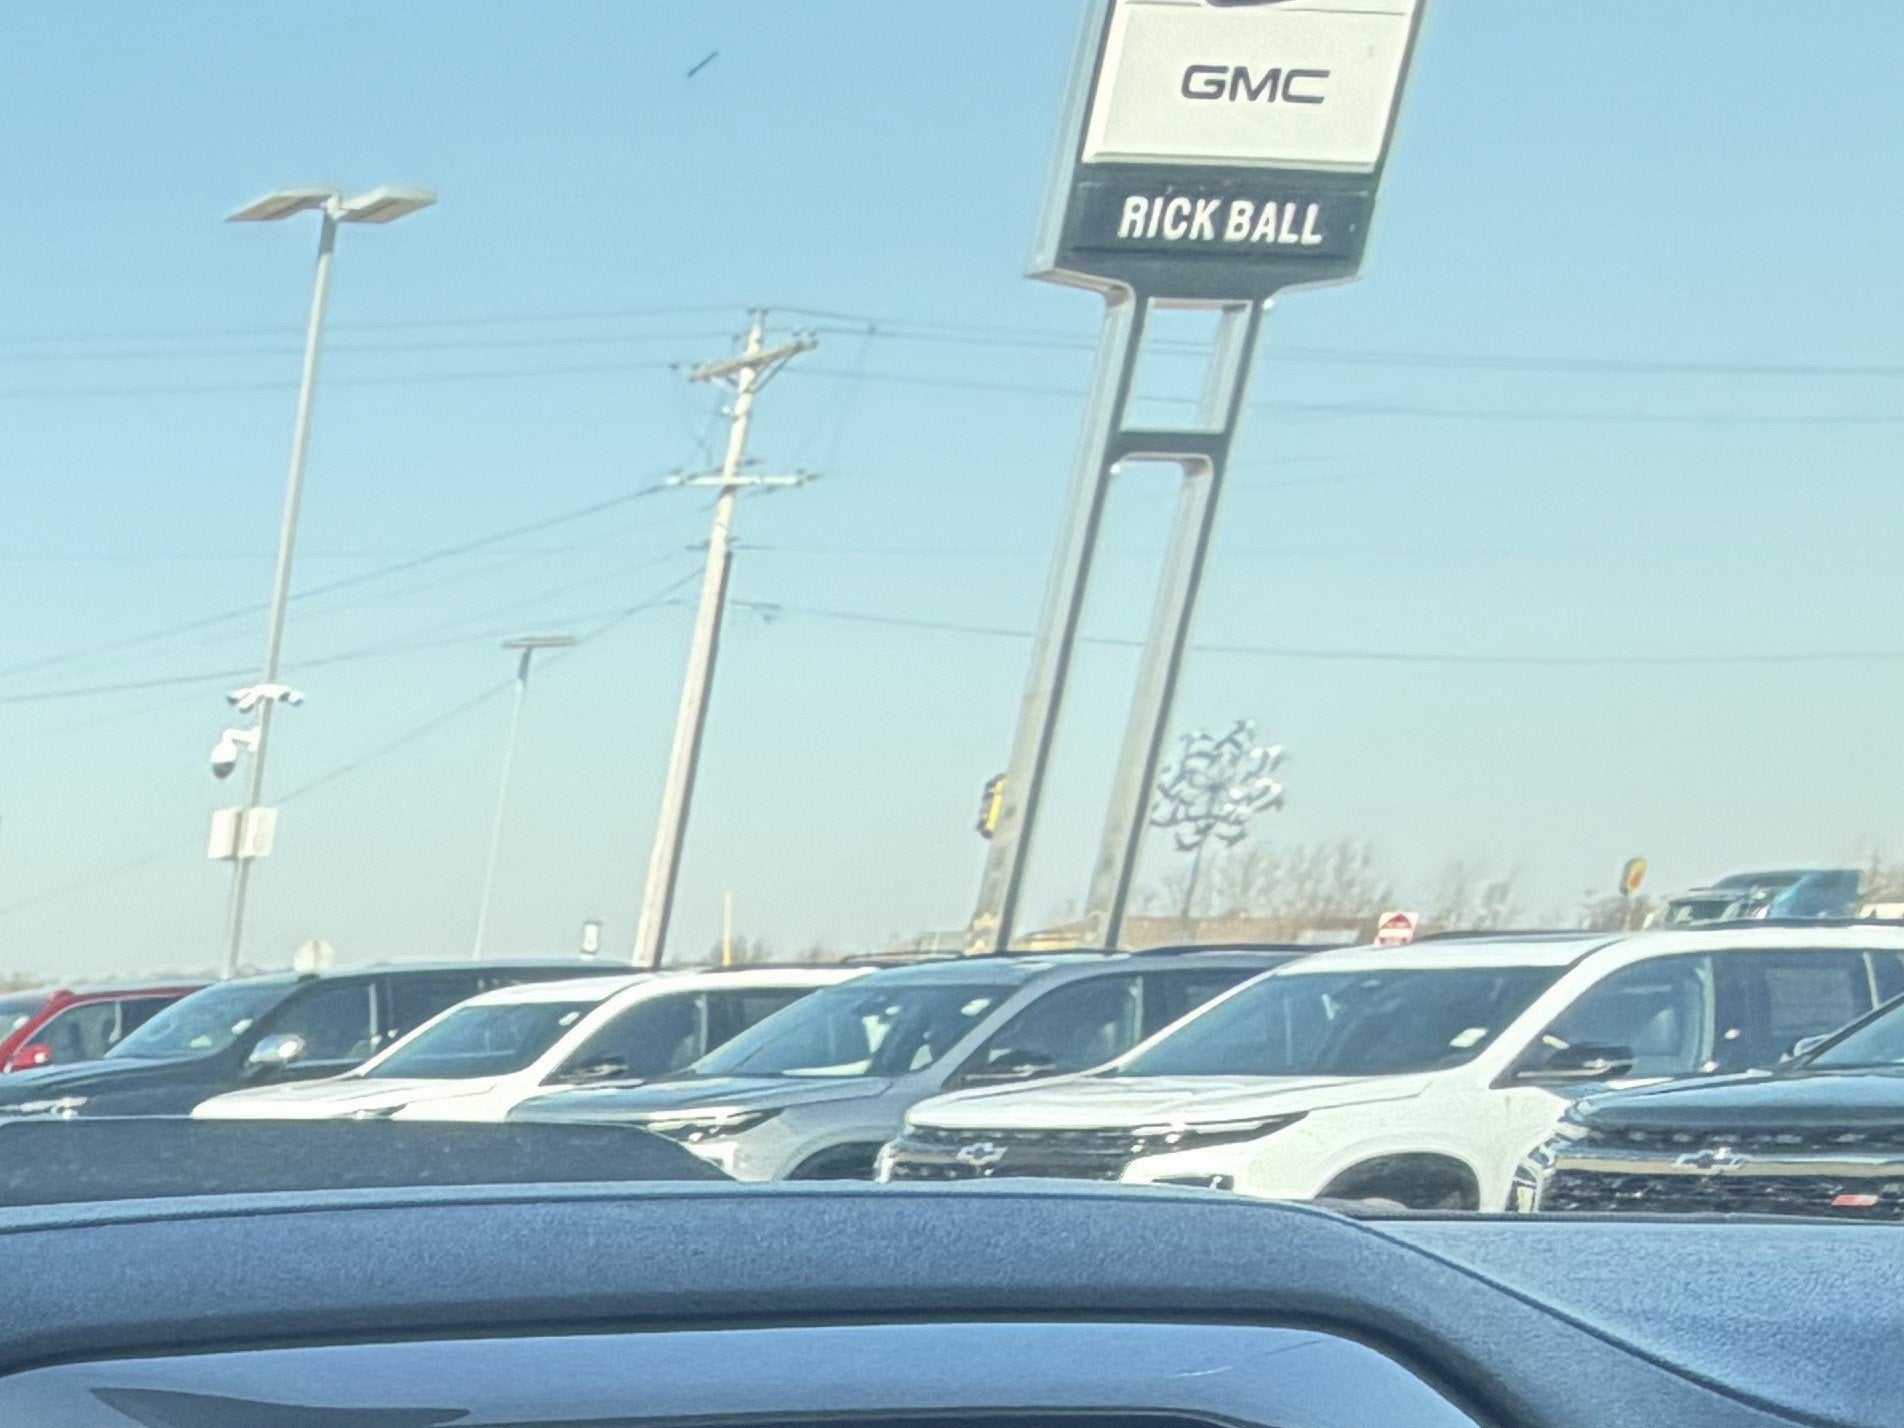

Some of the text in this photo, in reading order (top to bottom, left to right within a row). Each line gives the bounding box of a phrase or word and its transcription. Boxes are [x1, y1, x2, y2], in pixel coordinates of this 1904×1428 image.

[1180, 64, 1330, 104] GMC
[1117, 196, 1323, 245] RICK BALL
